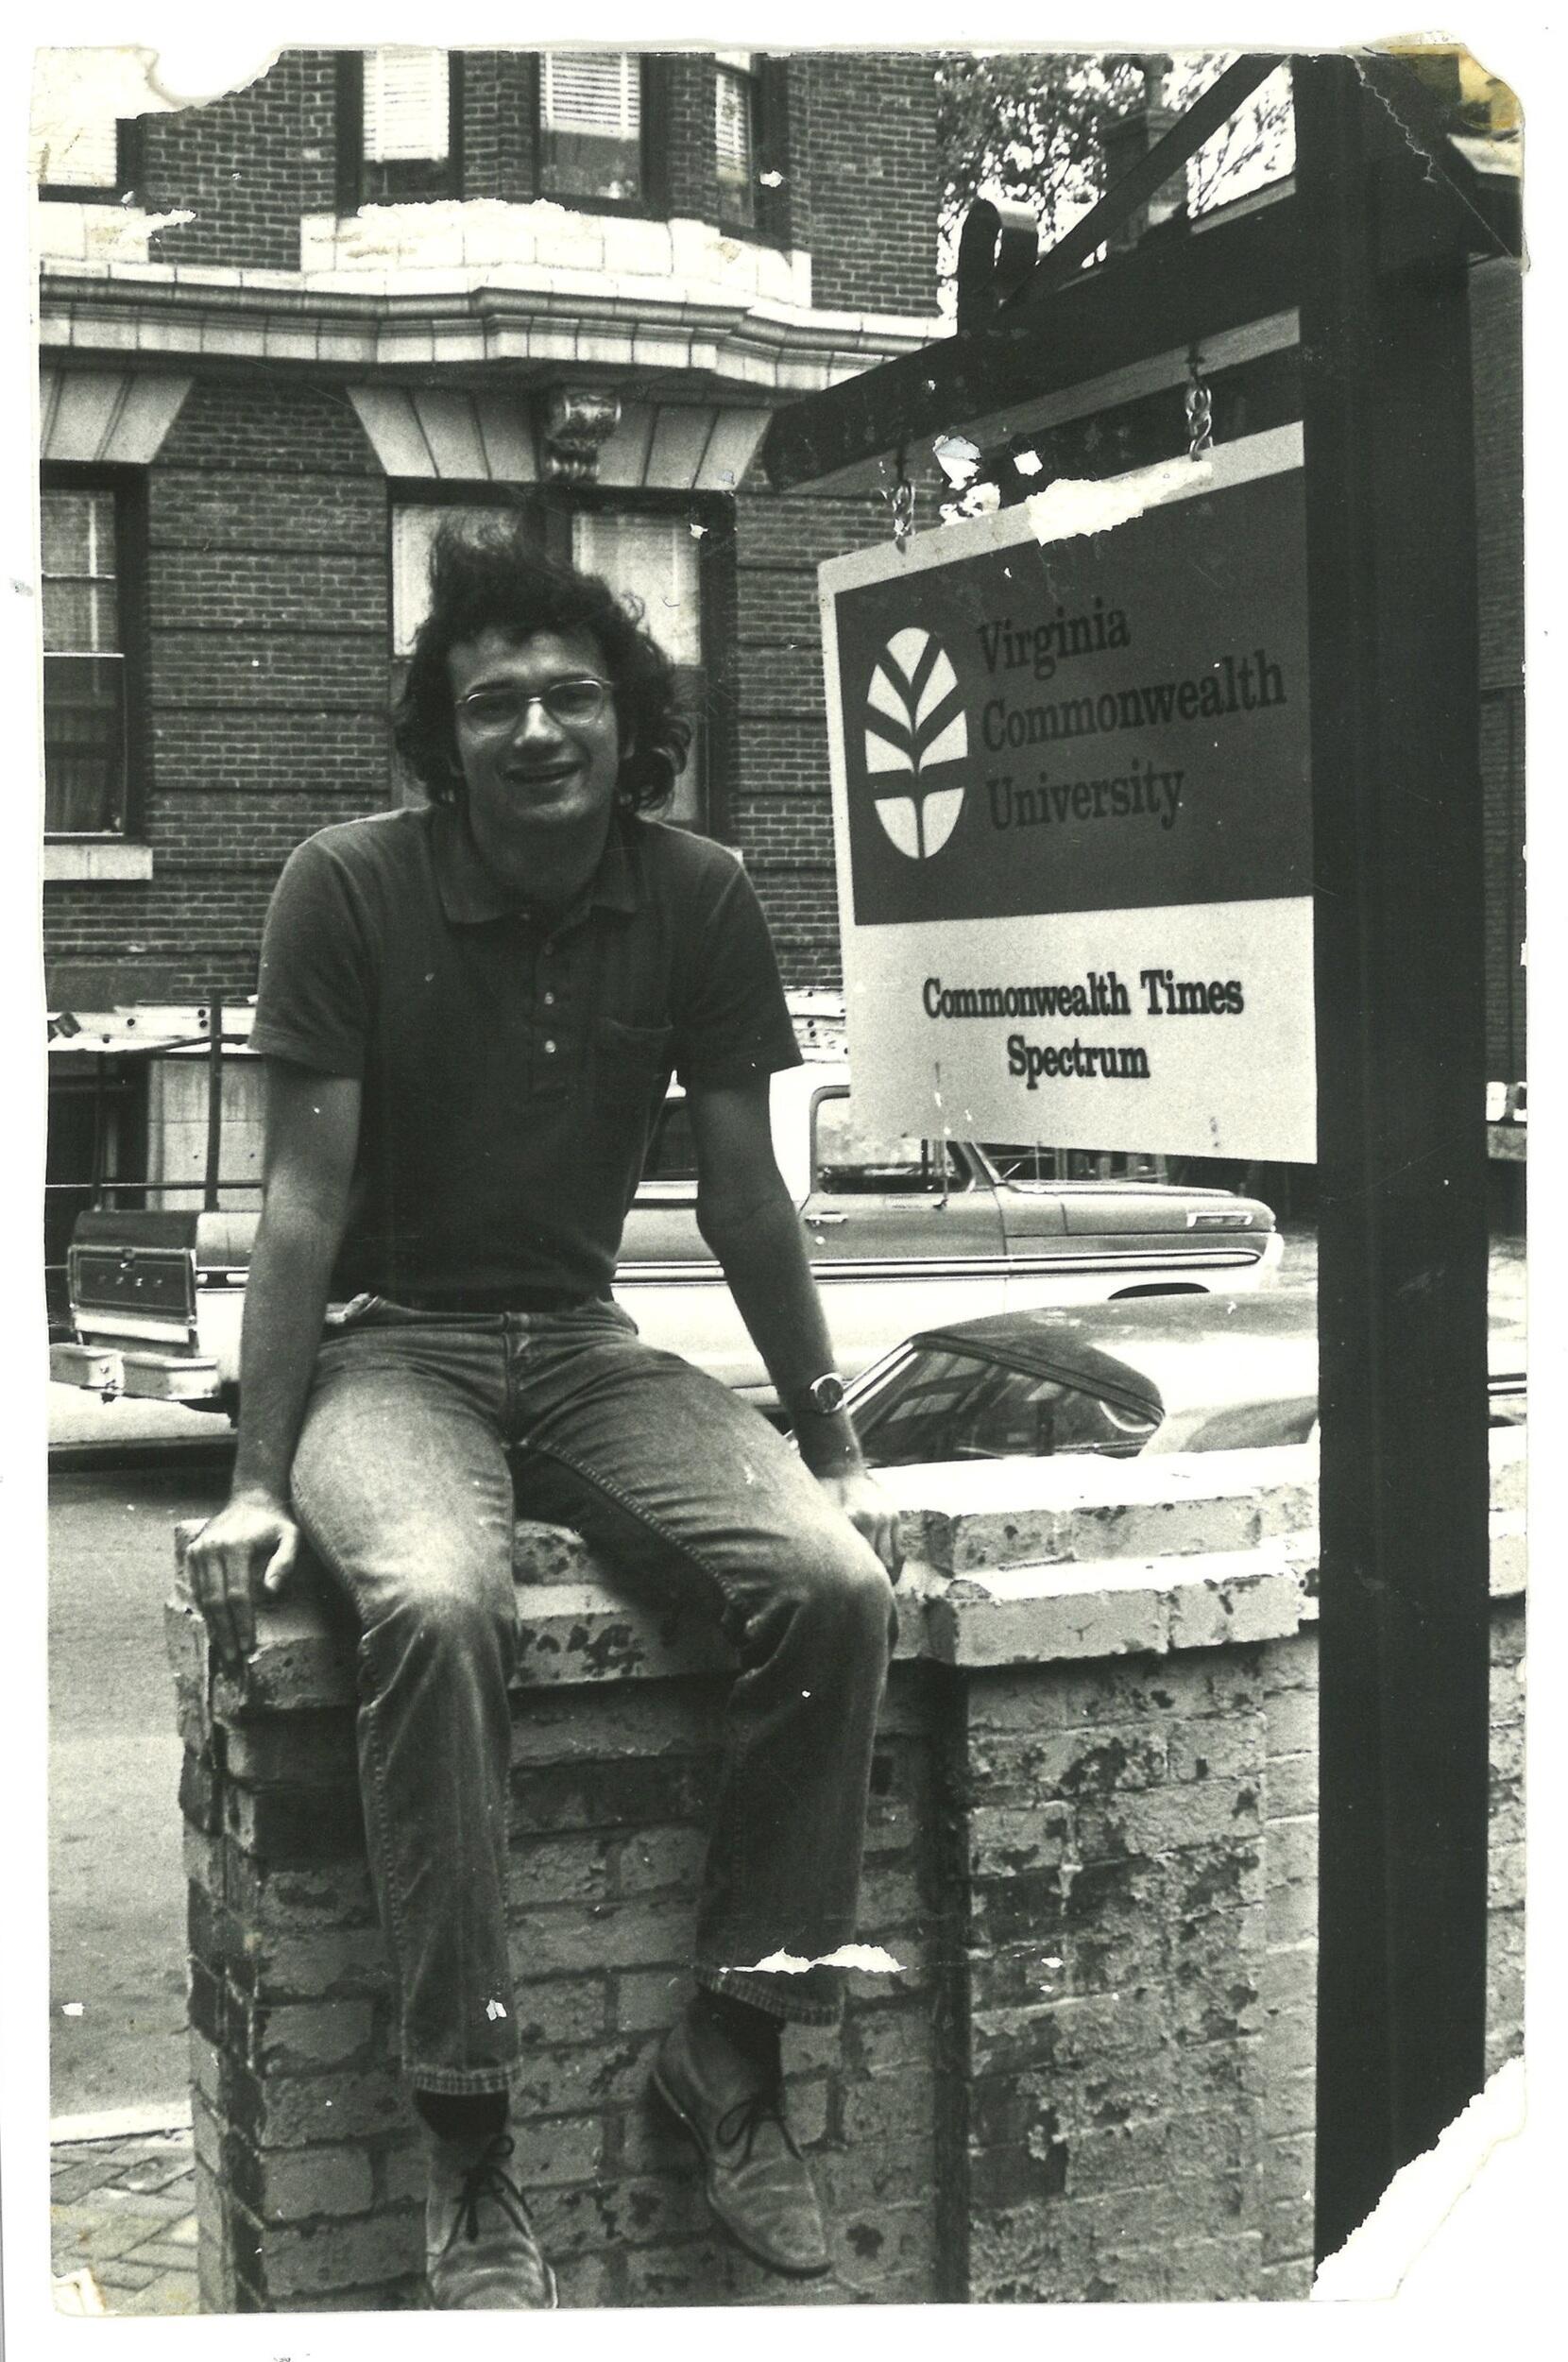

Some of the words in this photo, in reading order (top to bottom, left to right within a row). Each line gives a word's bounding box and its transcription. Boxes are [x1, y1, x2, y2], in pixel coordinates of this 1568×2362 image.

[977, 597, 1131, 680] Virginia
[982, 649, 1287, 752] Commonwealth
[986, 760, 1185, 830] University
[923, 971, 1131, 1018] Commonwealth
[1140, 969, 1244, 1016] Times
[1007, 1035, 1150, 1089] Spectrum
